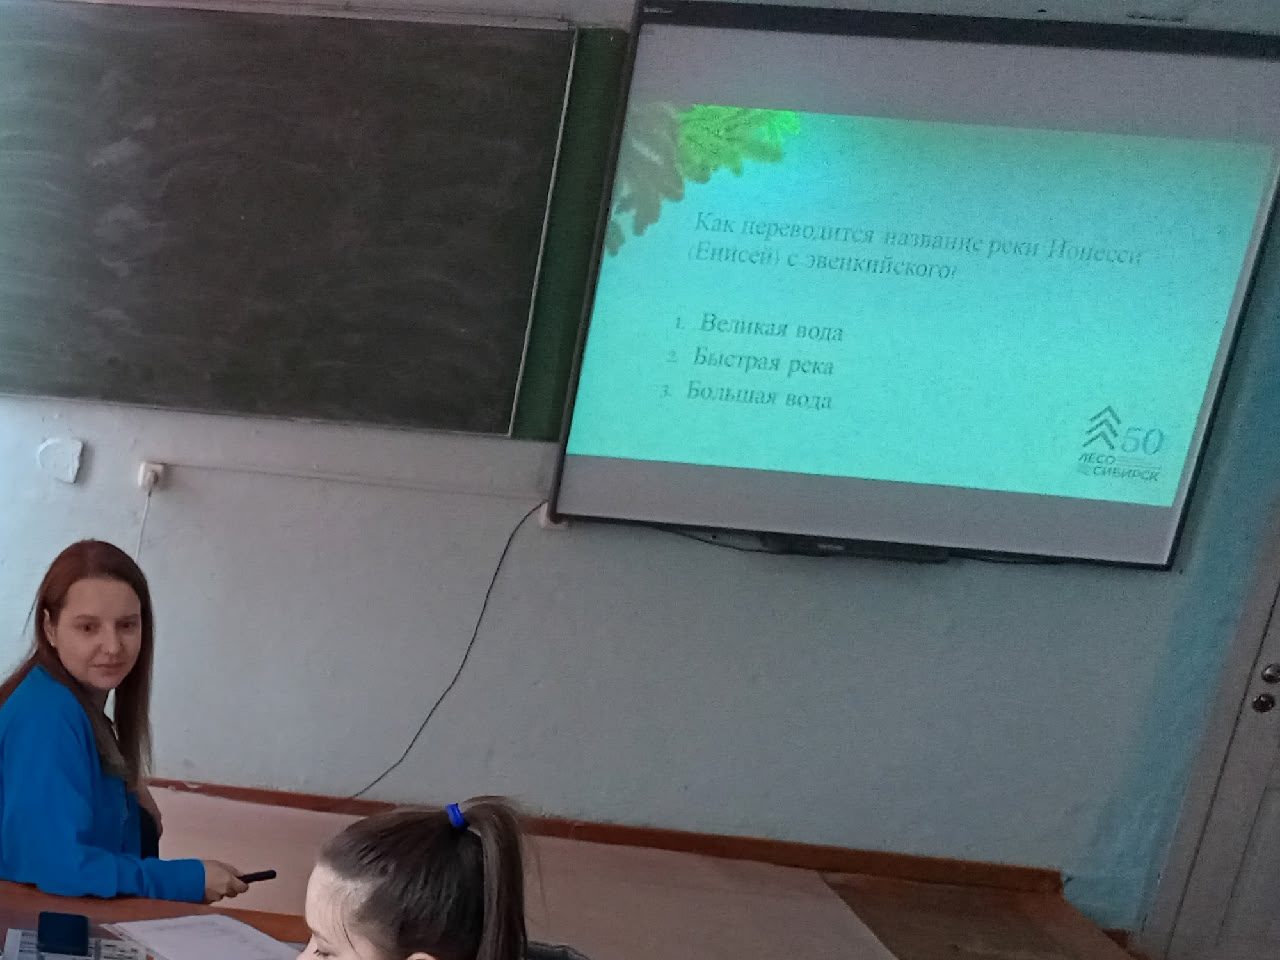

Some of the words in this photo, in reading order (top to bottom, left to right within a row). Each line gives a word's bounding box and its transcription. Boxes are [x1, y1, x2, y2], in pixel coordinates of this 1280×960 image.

[694, 212, 736, 234] Как
[741, 218, 875, 244] переводится
[883, 230, 984, 254] название
[986, 239, 1040, 259] реки
[787, 253, 799, 267] с
[699, 312, 788, 337] Великая
[795, 324, 844, 343] вода
[692, 346, 782, 374] Быстрая
[786, 358, 835, 379] река
[686, 379, 778, 406] Большая
[784, 391, 833, 412] вода
[1121, 427, 1165, 456] 50
[1078, 451, 1117, 465] ЛЕСО
